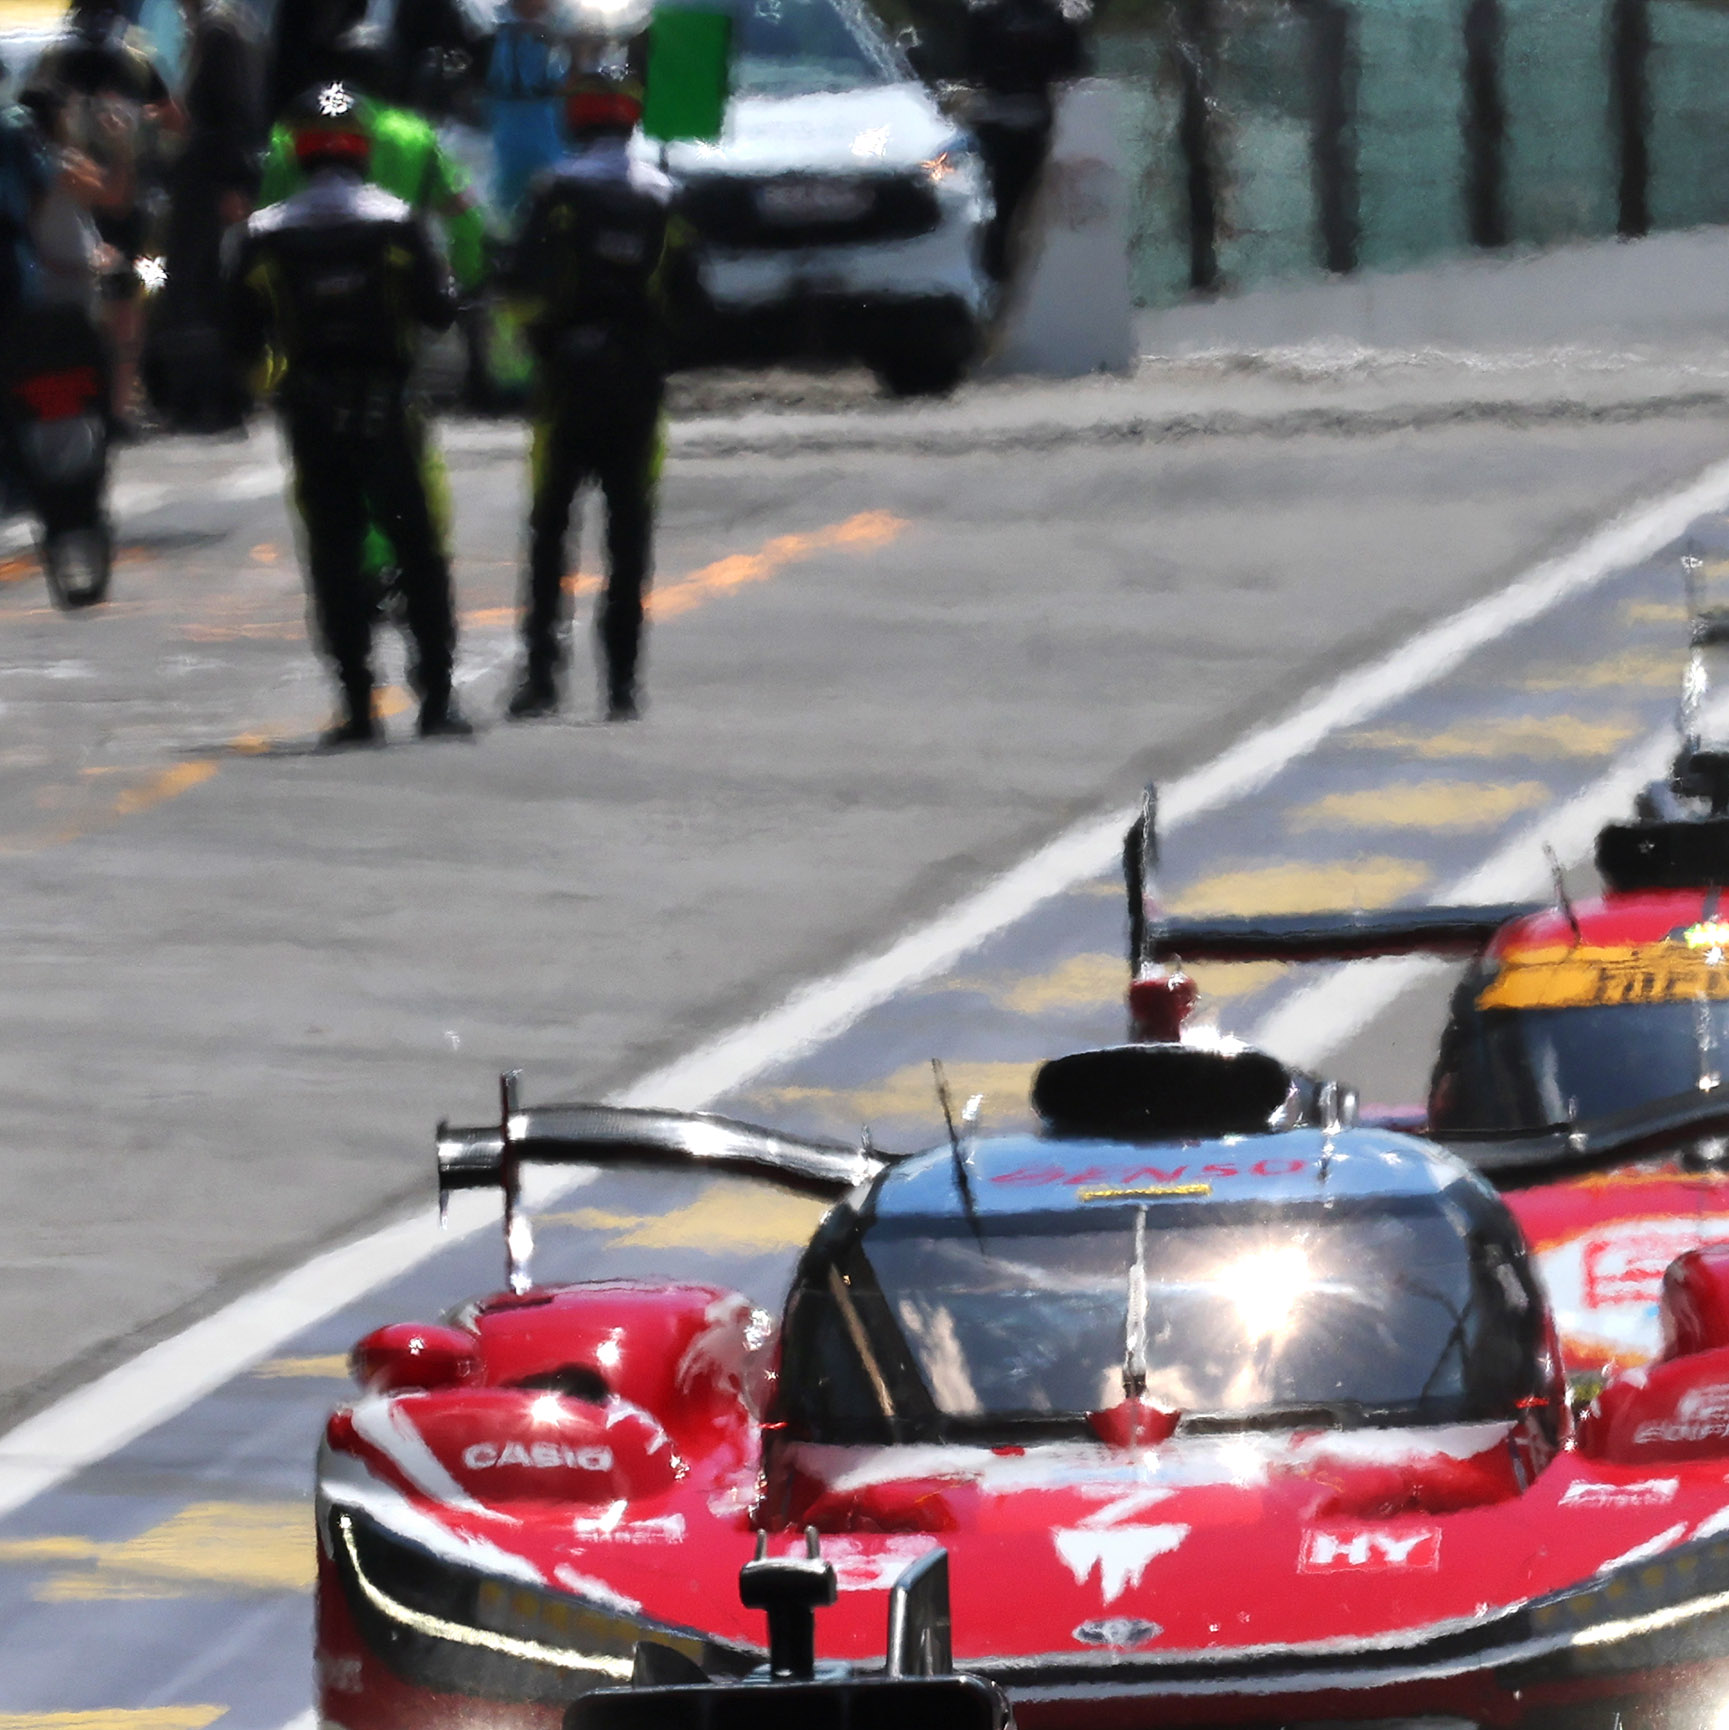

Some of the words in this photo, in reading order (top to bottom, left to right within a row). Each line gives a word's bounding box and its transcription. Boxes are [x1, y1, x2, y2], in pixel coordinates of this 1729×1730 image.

[988, 1158, 1310, 1187] DENSO
[460, 1440, 615, 1473] CASIO
[1308, 1531, 1432, 1567] HY
